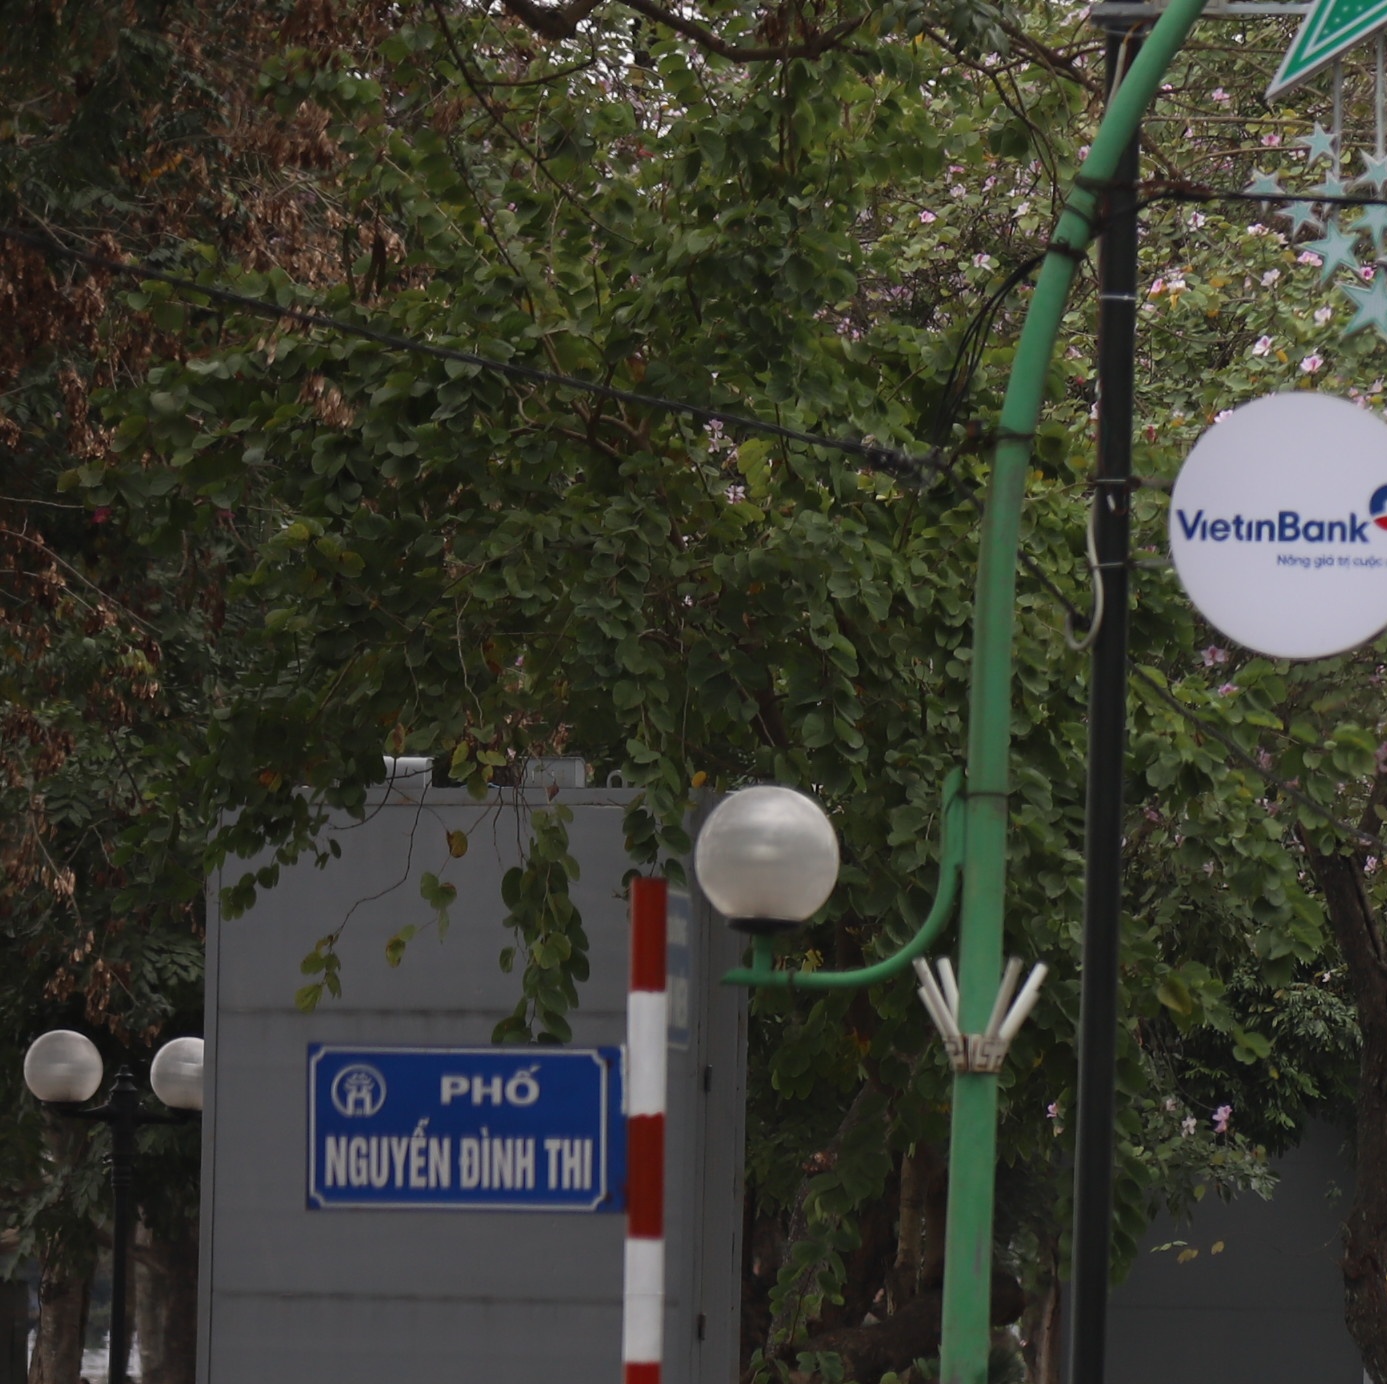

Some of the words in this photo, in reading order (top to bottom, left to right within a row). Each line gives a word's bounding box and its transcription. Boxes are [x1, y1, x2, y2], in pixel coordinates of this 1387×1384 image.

[1177, 510, 1369, 544] VietinBank
[1314, 555, 1334, 569] giá
[440, 1063, 541, 1105] PHỐ
[324, 1116, 450, 1189] NGUYỄN
[459, 1125, 535, 1190] ĐÌNH
[544, 1138, 593, 1190] THI
